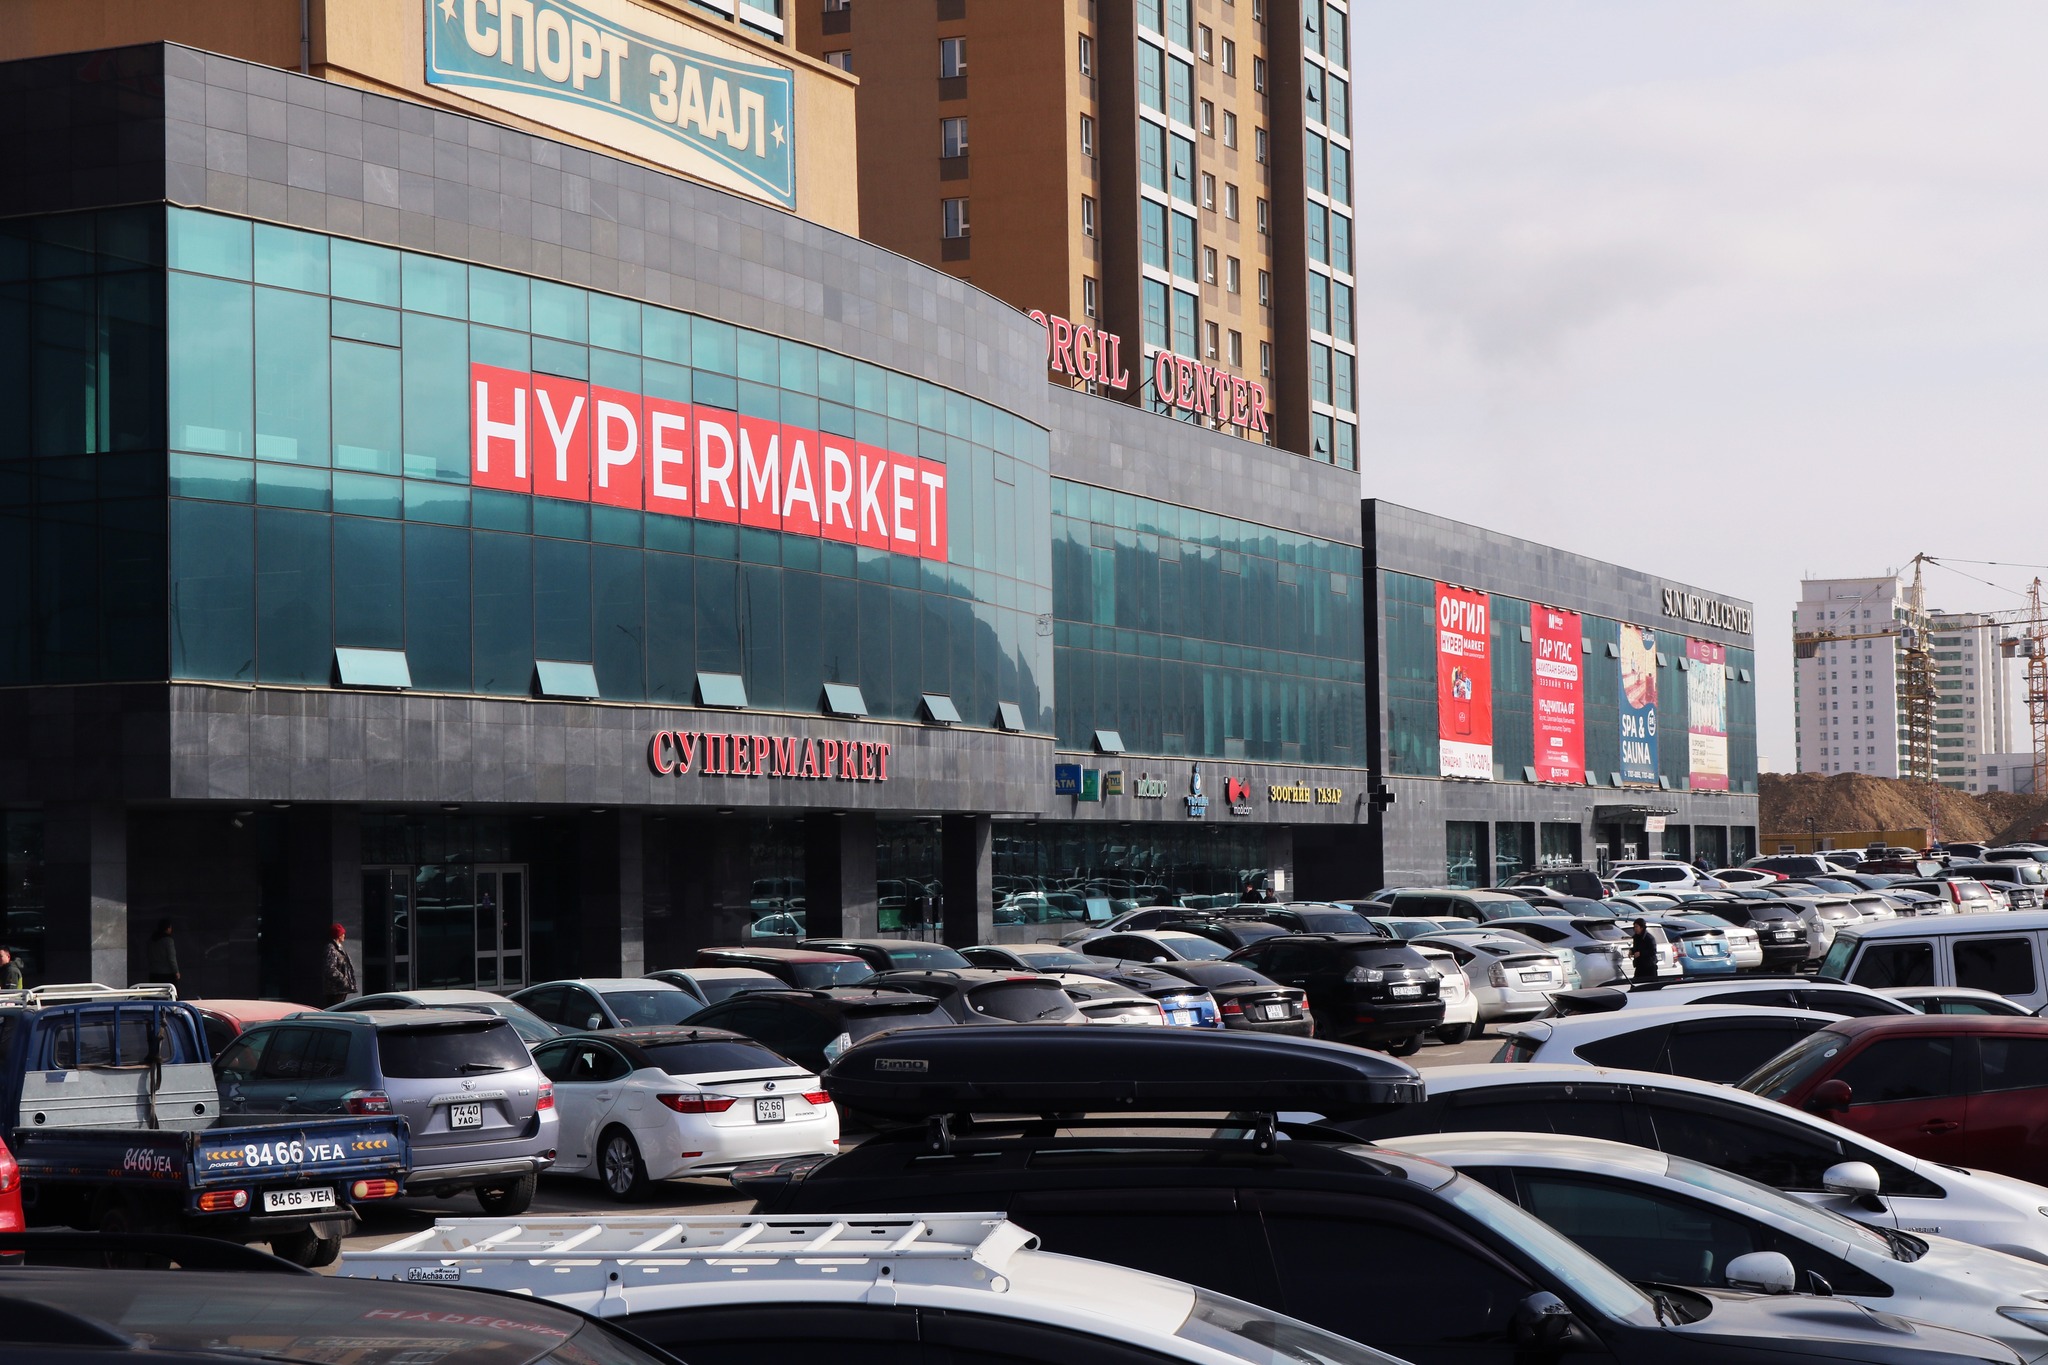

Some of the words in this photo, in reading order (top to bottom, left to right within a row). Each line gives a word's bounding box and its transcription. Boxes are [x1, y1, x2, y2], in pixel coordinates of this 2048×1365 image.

[463, 0, 629, 105] СПОРТ
[649, 53, 766, 158] ЗААЛ
[1154, 350, 1269, 433] CENTER
[476, 381, 944, 547] HYPERMARKET
[1440, 596, 1485, 635] ОРГИЛ
[1664, 587, 1682, 617] SUN
[1684, 592, 1722, 627] MEDICAL
[1722, 603, 1753, 635] CENTER
[1463, 638, 1485, 652] MARKET
[1539, 638, 1553, 658] ГАР
[1553, 640, 1572, 661] УТАС
[1622, 714, 1637, 738] SPA
[1638, 716, 1645, 738] &
[651, 730, 891, 781] СУПЕРМАРКЕТ
[1622, 740, 1652, 765] SAUNA
[1055, 779, 1076, 788] ATM
[1271, 780, 1311, 803] ЗООГИЙН
[1317, 788, 1342, 803] ГАЗАР
[153, 1155, 172, 1172] УЕА
[308, 1143, 346, 1162] УЕА
[310, 1190, 331, 1203] УЕА
[422, 1271, 459, 1280] Achaa.com
